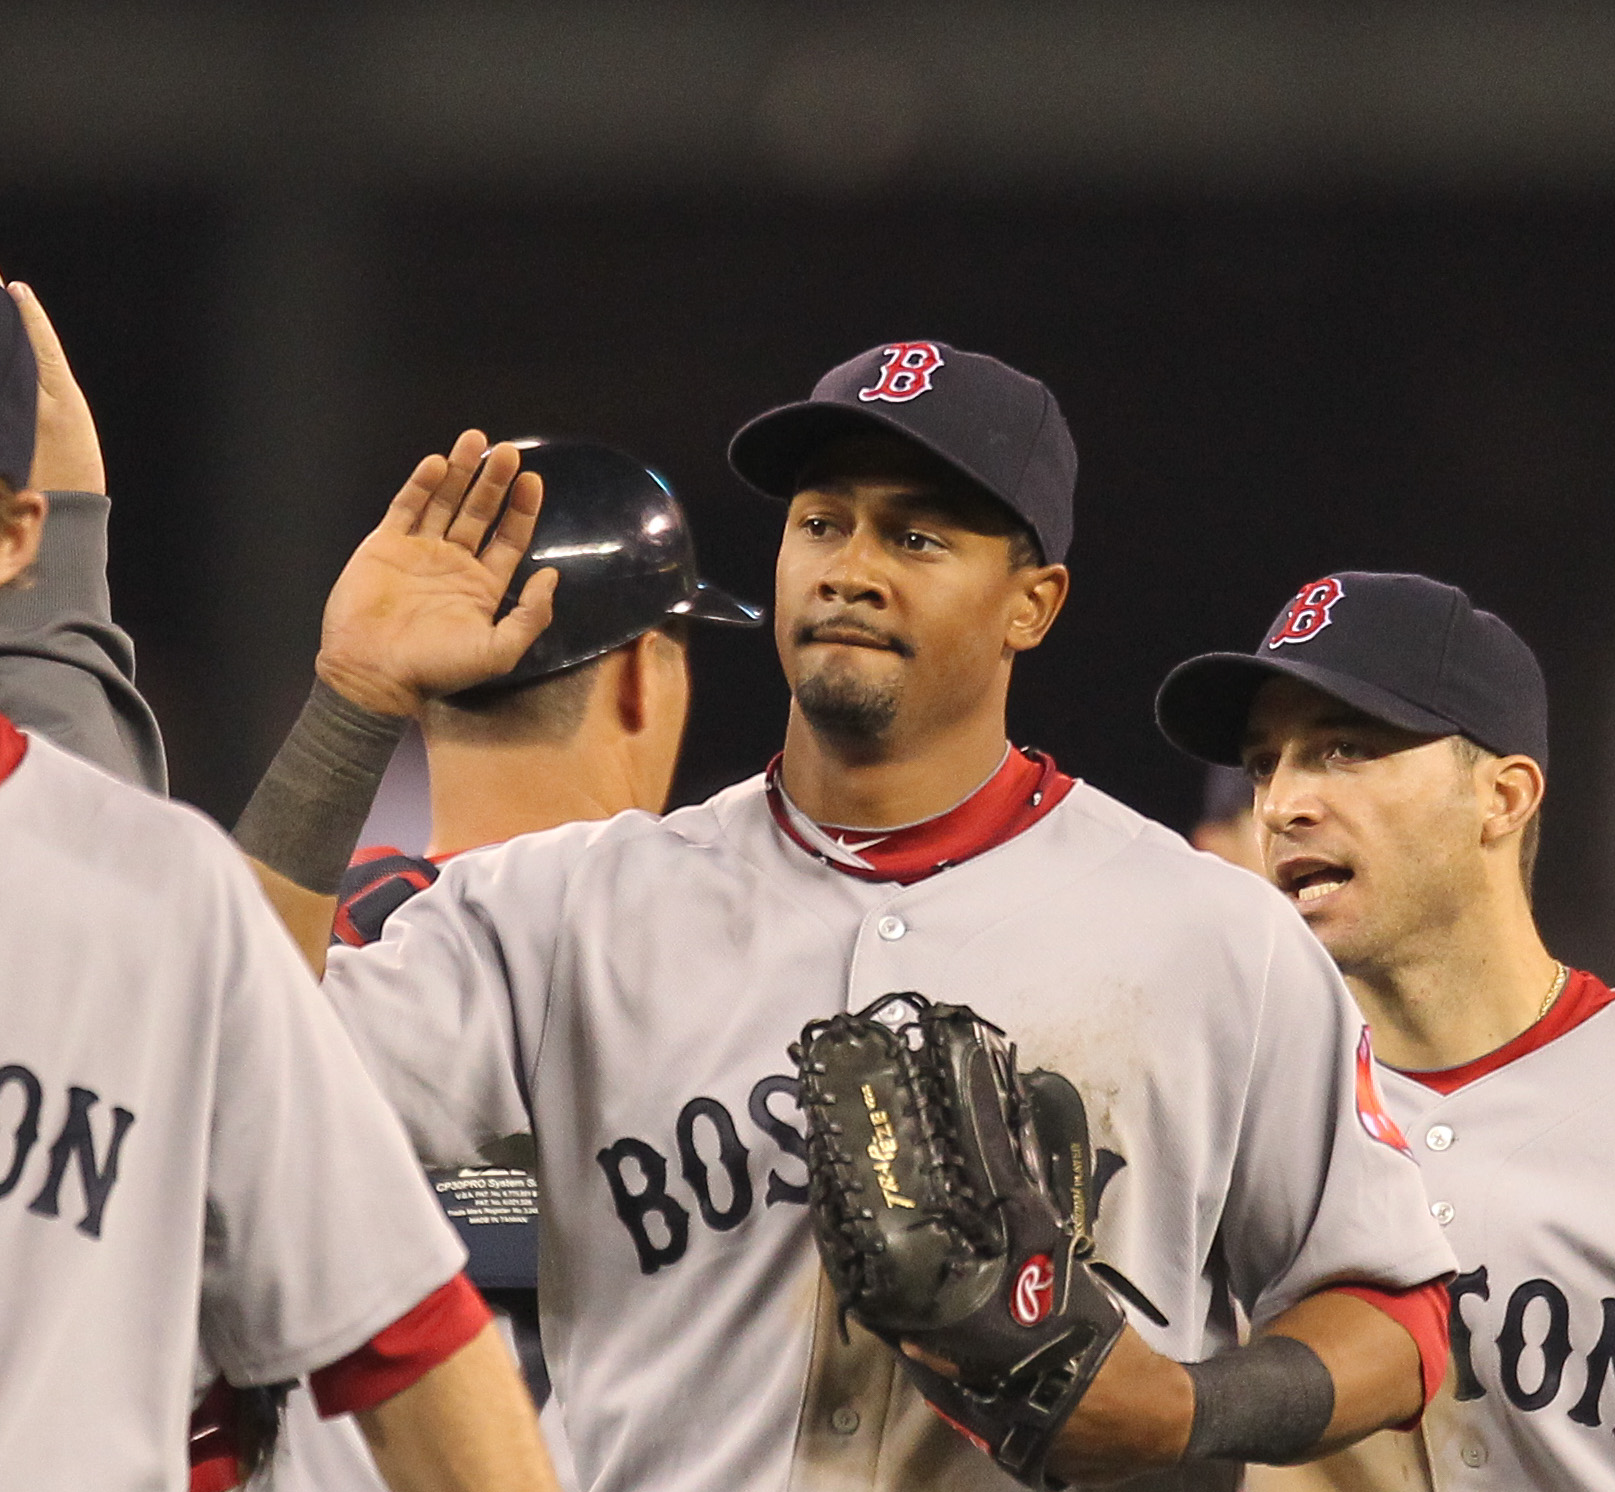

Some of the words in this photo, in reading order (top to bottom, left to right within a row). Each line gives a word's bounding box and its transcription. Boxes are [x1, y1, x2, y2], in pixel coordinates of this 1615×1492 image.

[858, 341, 946, 404] B
[1268, 577, 1344, 650] B
[487, 1178, 525, 1190] System
[594, 1075, 812, 1275] BOS
